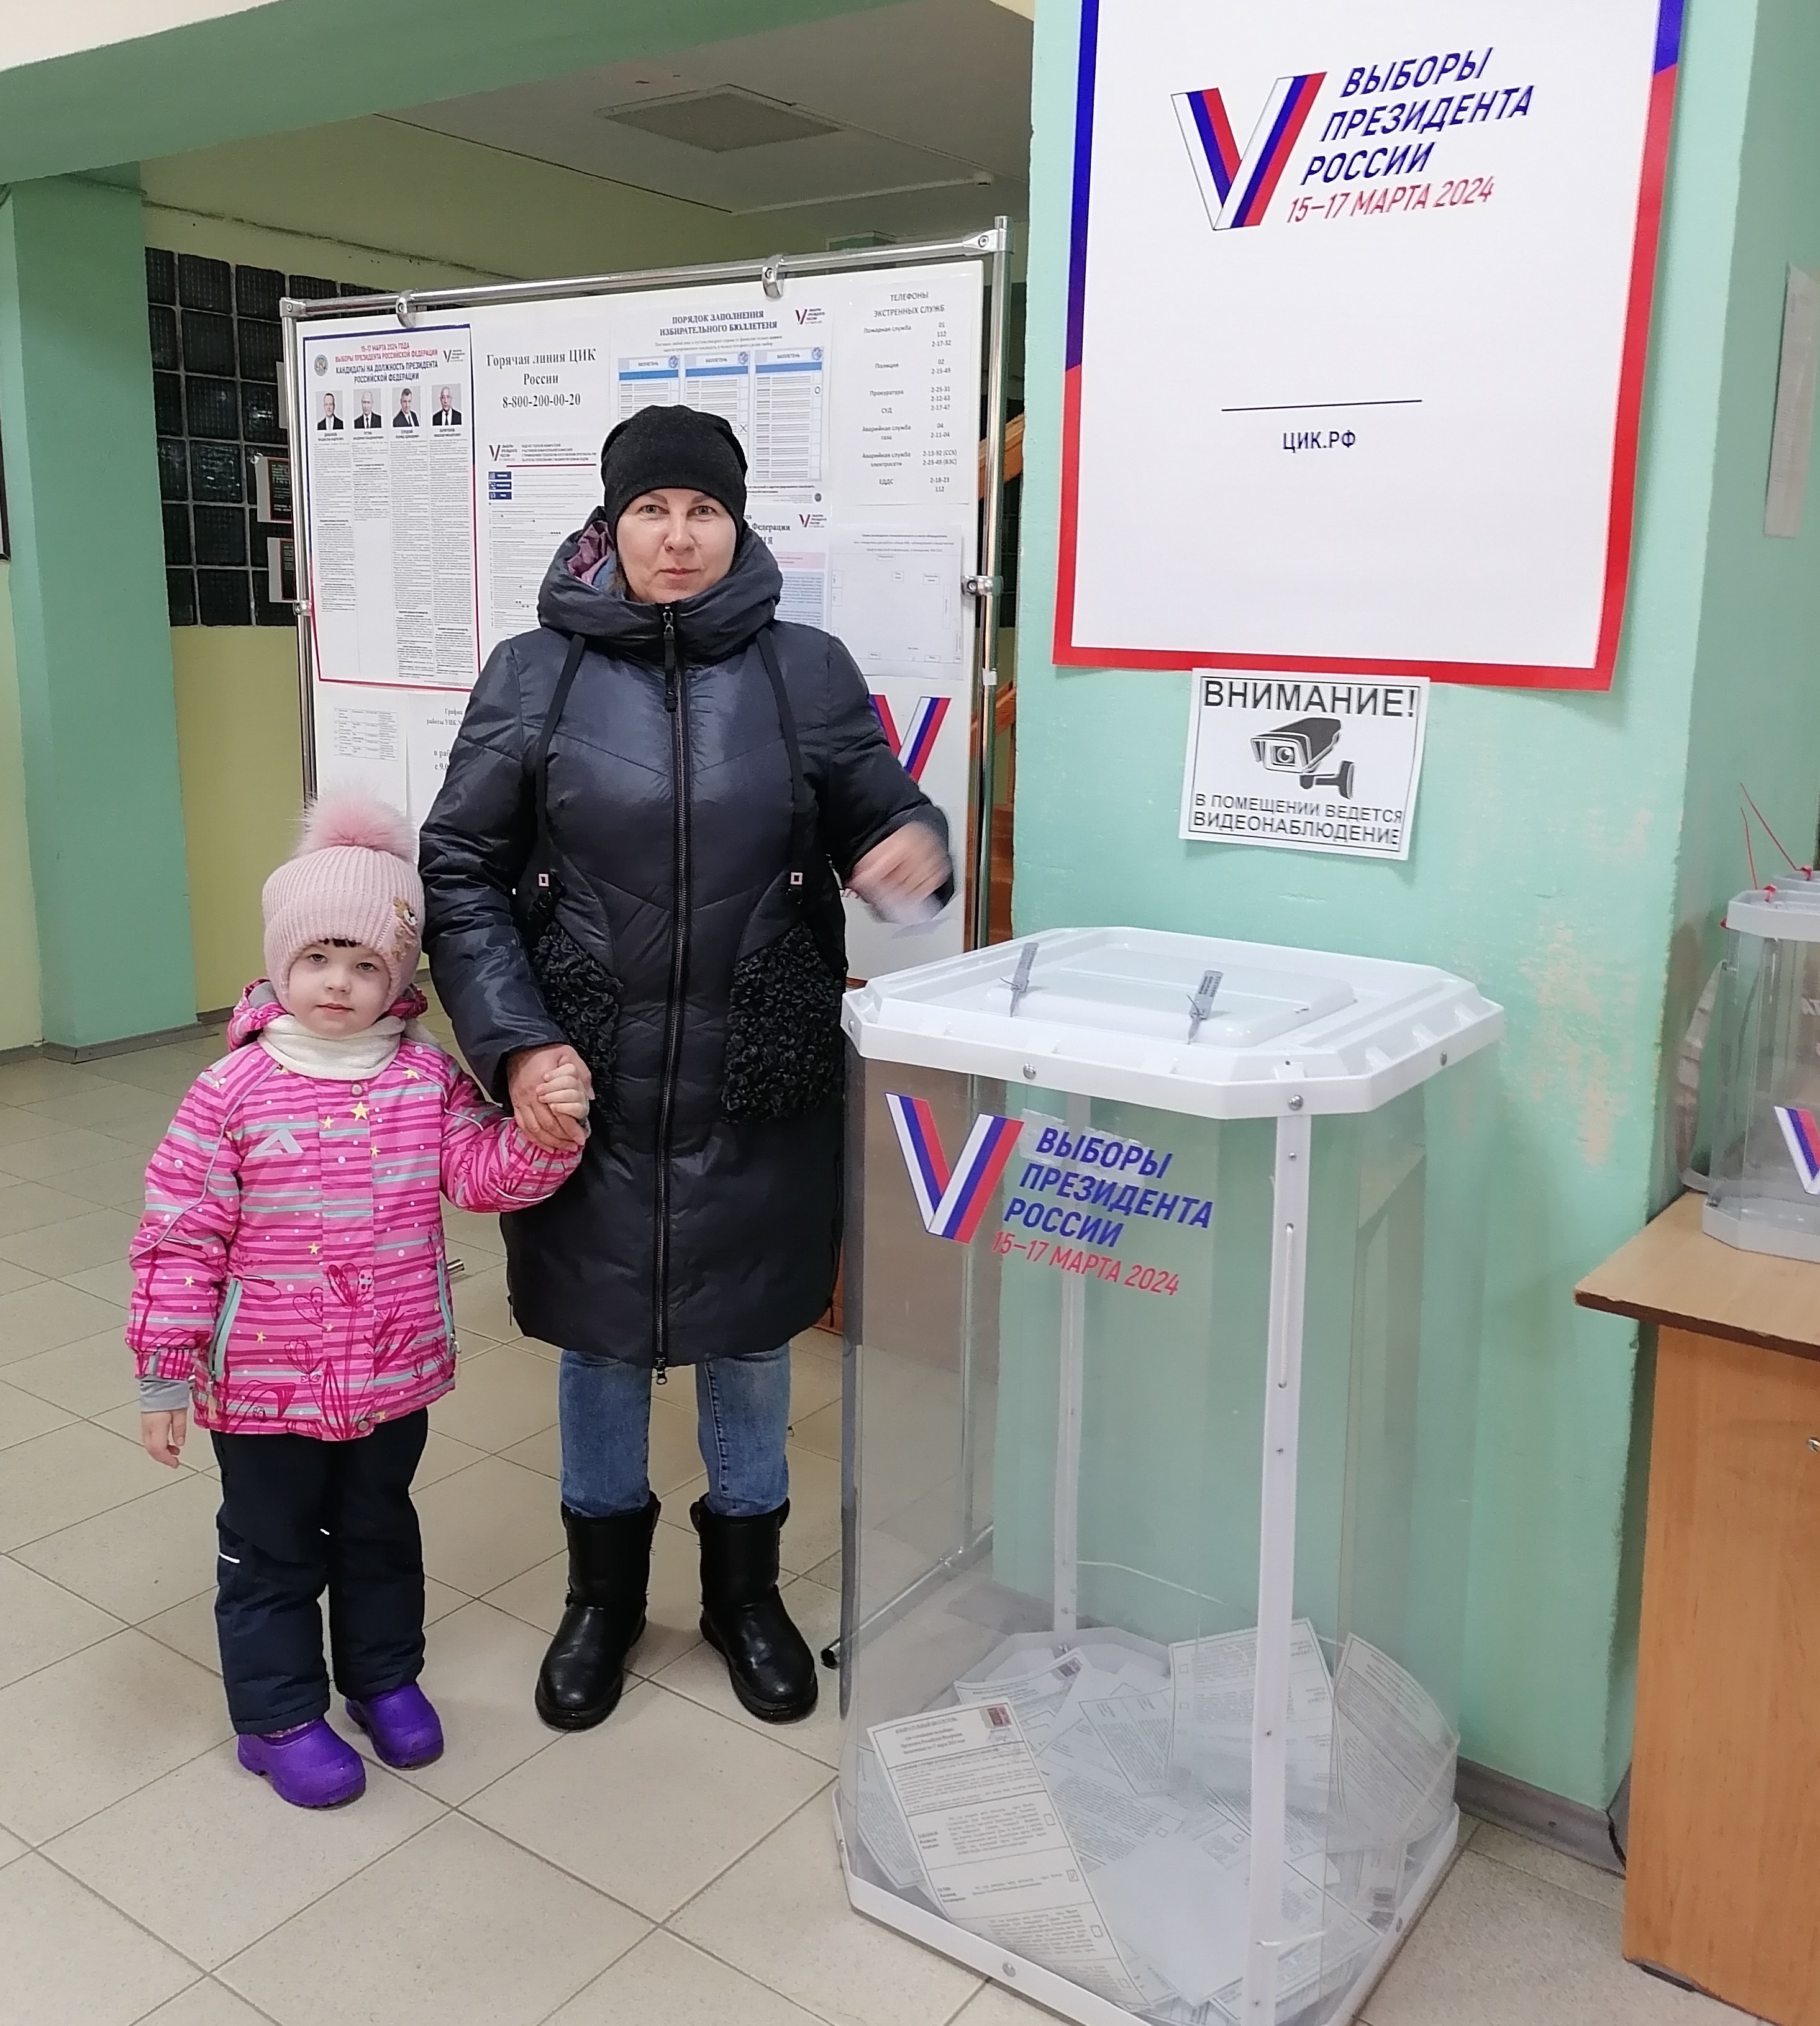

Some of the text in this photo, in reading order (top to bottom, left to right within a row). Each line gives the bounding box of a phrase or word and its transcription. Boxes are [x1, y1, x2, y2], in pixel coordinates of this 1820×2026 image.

[1340, 47, 1493, 98] ВЫБОРЫ
[1319, 85, 1534, 142] ПРЕЗИДЕНТА
[1301, 142, 1435, 186] РОССИИ
[1350, 184, 1429, 217] МАРТА
[1434, 176, 1495, 208] 2024
[890, 292, 929, 302] ТЕЛЕФОНЫ
[671, 311, 764, 325] ПОРЯДОК ЗАПОЛНЕНИЯ
[873, 304, 945, 317] ЭКСТРЕННЫХ СЛУЖБ
[659, 321, 778, 337] ИЗБИРАТЕЛЬНОГО БЮЛЛЕТЕНЯ
[892, 324, 911, 334] служба
[354, 353, 381, 361] ПРЕЗИДЕНТА
[382, 350, 411, 360] РОССИЙСКОЙ
[411, 349, 438, 357] ФЕДЕРАЦИИ
[486, 348, 596, 369] Горячая линия ЦИК
[336, 360, 438, 375] КАНДИДАТЫ НА ДОЛЖНОСТЬ ПРЕЗИДЕНТА
[354, 373, 419, 384] РОССИЙСКОЙ ФЕДЕРАЦИИ
[523, 373, 559, 386] России
[502, 393, 581, 408] 8-800-200-00-20
[1283, 429, 1356, 453] ЦИК.РФ
[891, 451, 911, 459] служба
[752, 523, 791, 533] Федерации
[1204, 680, 1416, 717] ВНИМАНИЕ!
[445, 708, 463, 716] График
[1195, 793, 1402, 824] В ПОМЕЩЕНИИ ВЕДЕТСЯ
[1193, 811, 1399, 845] ВИДЕОНАБЛЮДЕНИЕ
[1035, 1127, 1173, 1179] ВЫБОРЫ
[1019, 1163, 1214, 1229] ПРЕЗИДЕНТА
[1004, 1197, 1124, 1248] РОССИИ
[1049, 1245, 1121, 1283] МАРТА
[1124, 1264, 1180, 1296] 2024
